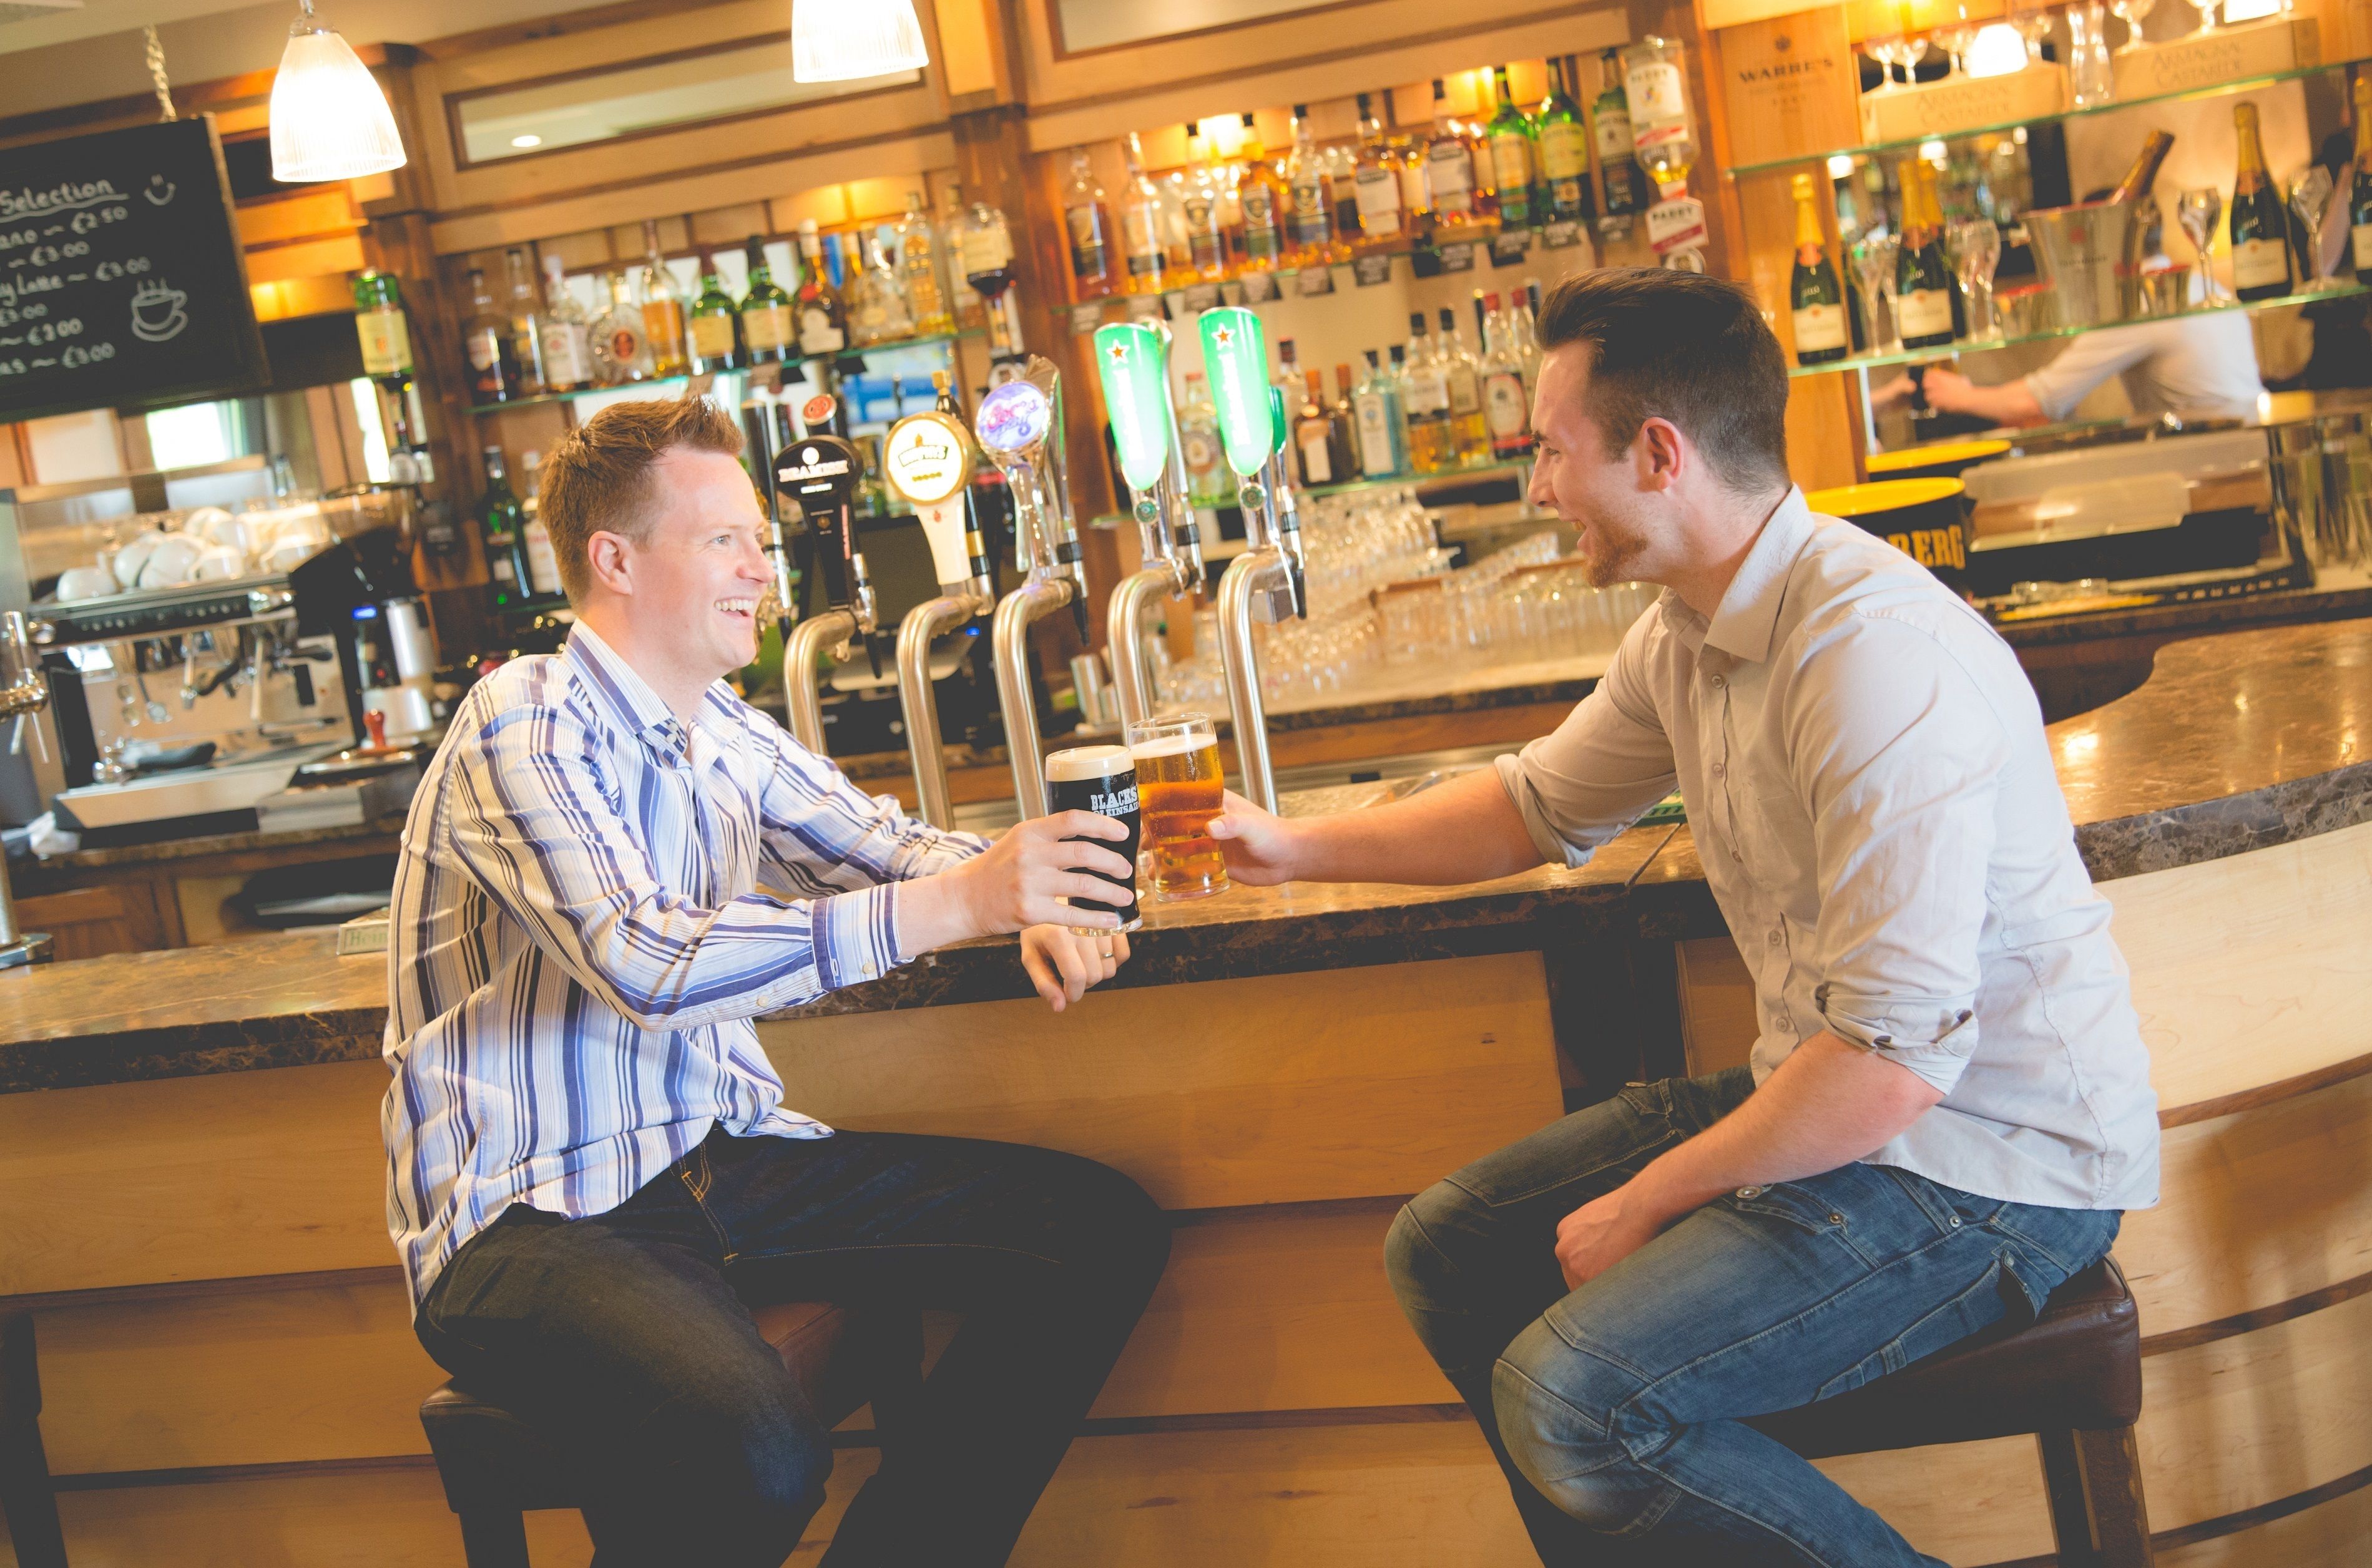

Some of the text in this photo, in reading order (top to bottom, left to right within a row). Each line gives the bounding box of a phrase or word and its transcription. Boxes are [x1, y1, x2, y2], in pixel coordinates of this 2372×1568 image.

[0, 179, 116, 215] Selection
[1880, 524, 1966, 571] BERG
[1090, 786, 1138, 811] BLACKS
